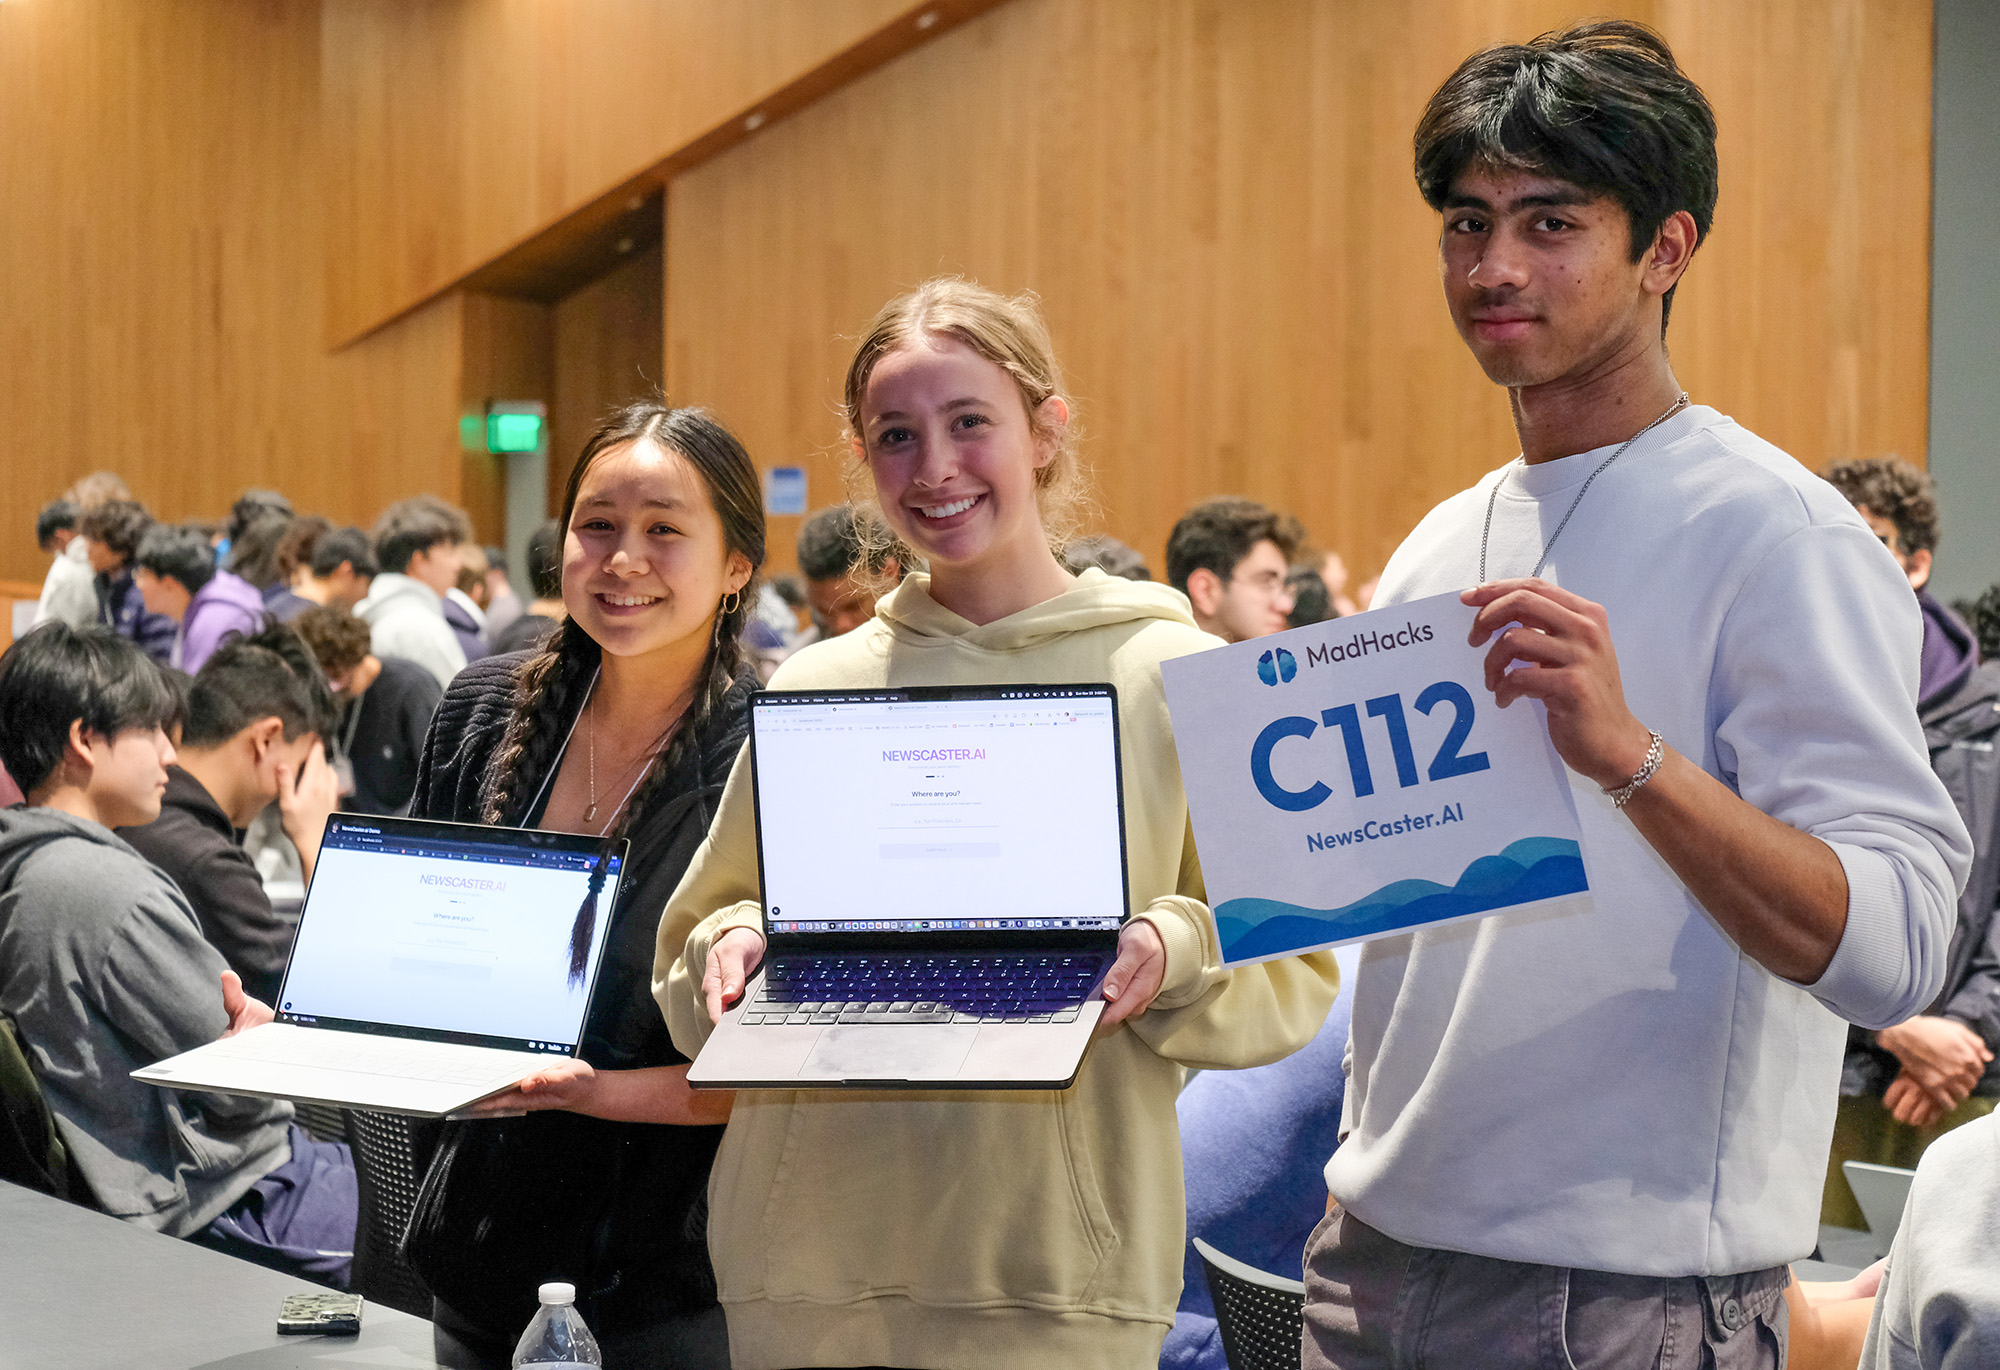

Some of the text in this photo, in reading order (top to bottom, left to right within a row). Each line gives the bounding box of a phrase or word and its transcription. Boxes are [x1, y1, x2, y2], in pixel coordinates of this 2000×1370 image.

[1306, 621, 1434, 668] MadHacks
[882, 748, 986, 762] NEWSCASTER.AI
[1251, 681, 1491, 812] C112
[945, 790, 961, 798] you?
[1306, 803, 1464, 852] NewsCaster.AI
[419, 874, 506, 892] NEWSCASTER.AI
